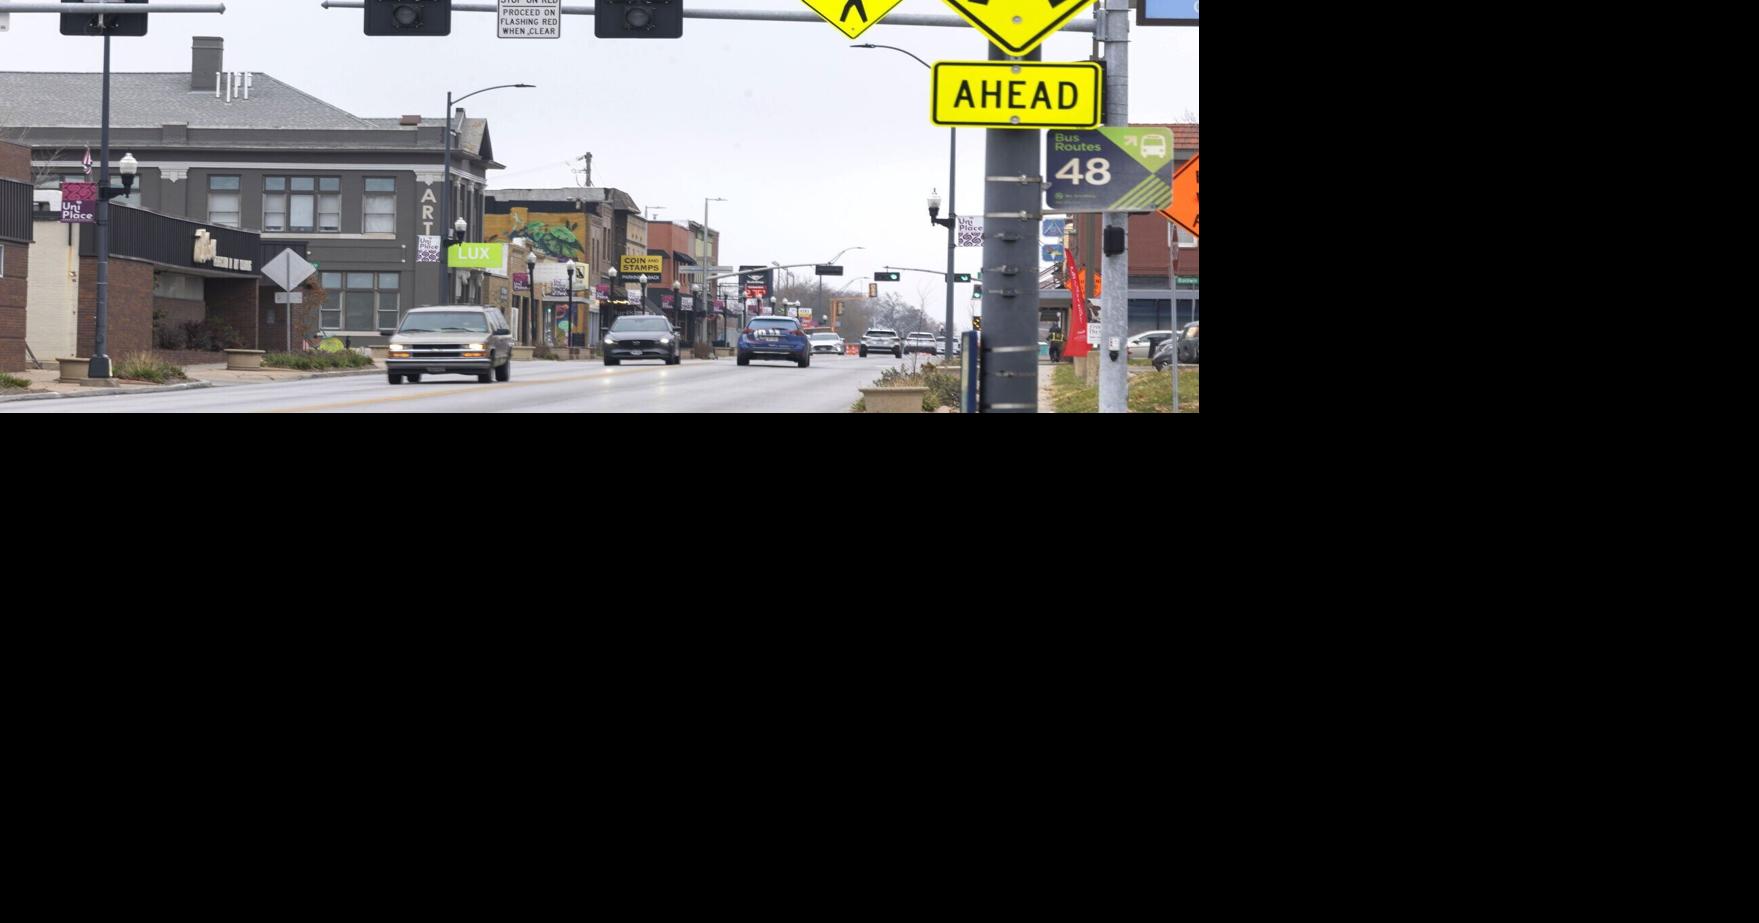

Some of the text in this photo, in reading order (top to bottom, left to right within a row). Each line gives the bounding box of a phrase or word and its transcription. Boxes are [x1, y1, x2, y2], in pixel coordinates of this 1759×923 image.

[953, 80, 1078, 110] AHEAD
[1055, 133, 1080, 142] Bus
[1055, 143, 1102, 151] Routes
[1055, 157, 1111, 185] 48
[62, 201, 82, 213] Uni
[421, 188, 437, 235] ART
[62, 211, 93, 219] Place
[959, 217, 973, 226] Uni
[458, 247, 489, 259] LUX
